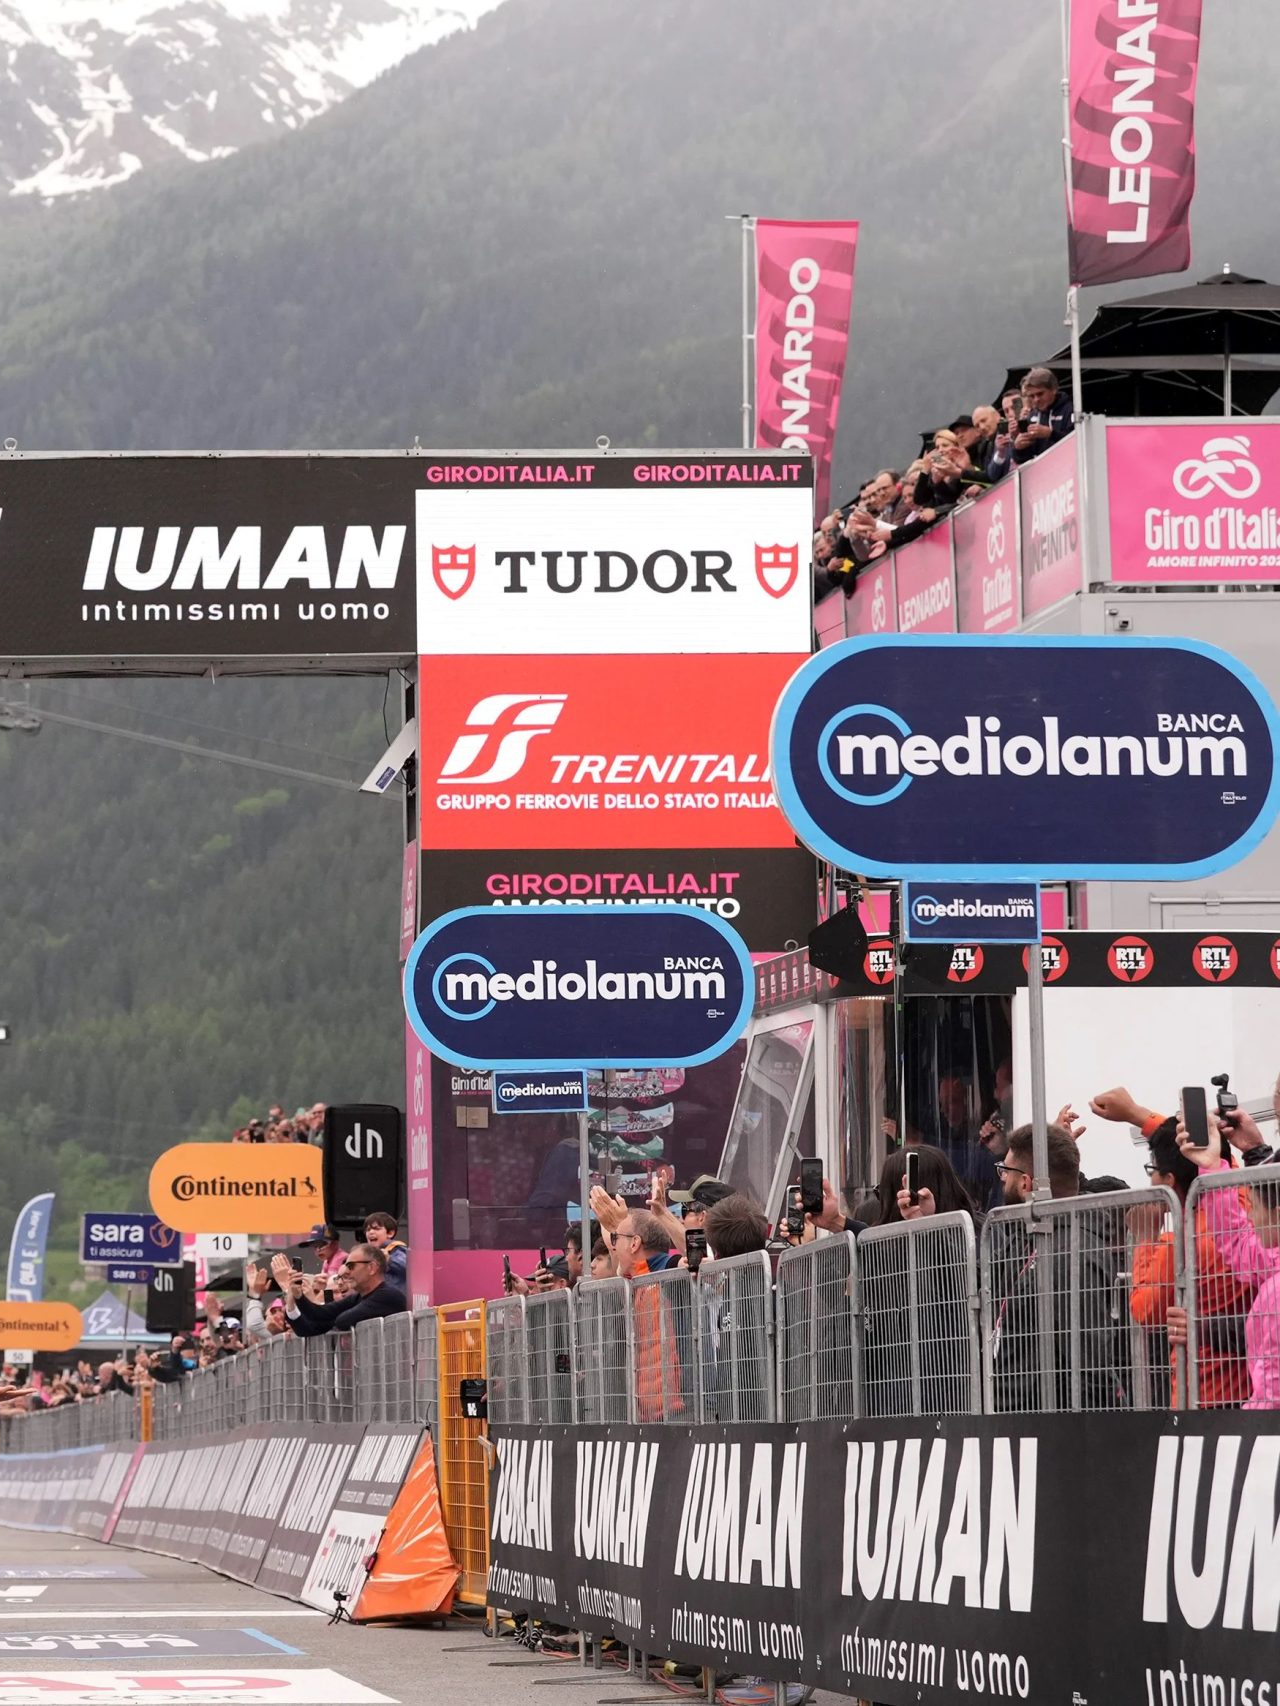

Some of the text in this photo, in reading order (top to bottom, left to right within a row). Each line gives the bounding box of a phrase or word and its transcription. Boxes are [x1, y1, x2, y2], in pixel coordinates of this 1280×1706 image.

[426, 465, 595, 483] GIRODITALIA.IT
[633, 464, 802, 482] GIRODITALIA.IT
[1032, 478, 1074, 538] AMORE
[1145, 507, 1280, 551] Giro d'Itali
[82, 525, 407, 591] IUMAN
[1147, 556, 1258, 568] AMORE INFINITO
[495, 549, 737, 594] TUDOR
[82, 600, 390, 621] intimissimi uomo
[899, 577, 950, 632] LEONARDO
[1157, 713, 1245, 733] BANCA
[837, 716, 1247, 777] mediolanum
[437, 794, 510, 810] GRUPPO
[516, 794, 599, 809] FERROVIE
[604, 793, 659, 809] DELLO
[664, 793, 719, 809] STATO
[486, 873, 740, 895] GIRODITALIA.IT
[917, 899, 1035, 918] mediolanum
[664, 957, 723, 970] BANCA
[869, 950, 892, 964] RTL
[1116, 948, 1144, 961] RTL
[1201, 948, 1229, 961] RTL
[870, 963, 894, 972] 102.5
[1116, 961, 1146, 969] 102.5
[1201, 961, 1231, 969] 102.5
[445, 959, 725, 1000] mediolanum
[502, 1083, 582, 1096] mediolanum
[171, 1175, 297, 1201] Continental
[90, 1224, 144, 1243] sara
[90, 1246, 144, 1258] ti assicura
[211, 1236, 232, 1251] 10
[113, 1270, 136, 1279] sara
[12, 1353, 24, 1361] 50
[279, 1444, 355, 1533] IUMAN
[574, 1441, 660, 1568] IUMAN
[674, 1442, 807, 1589] IUMAN
[841, 1437, 1038, 1613] IUMAN
[536, 1575, 557, 1606] uomo
[578, 1580, 642, 1630] intimissimi uomo
[4, 1633, 181, 1641] BANCA
[671, 1602, 804, 1662] intimissimi uomo
[841, 1626, 1029, 1699] intimissimi uomo
